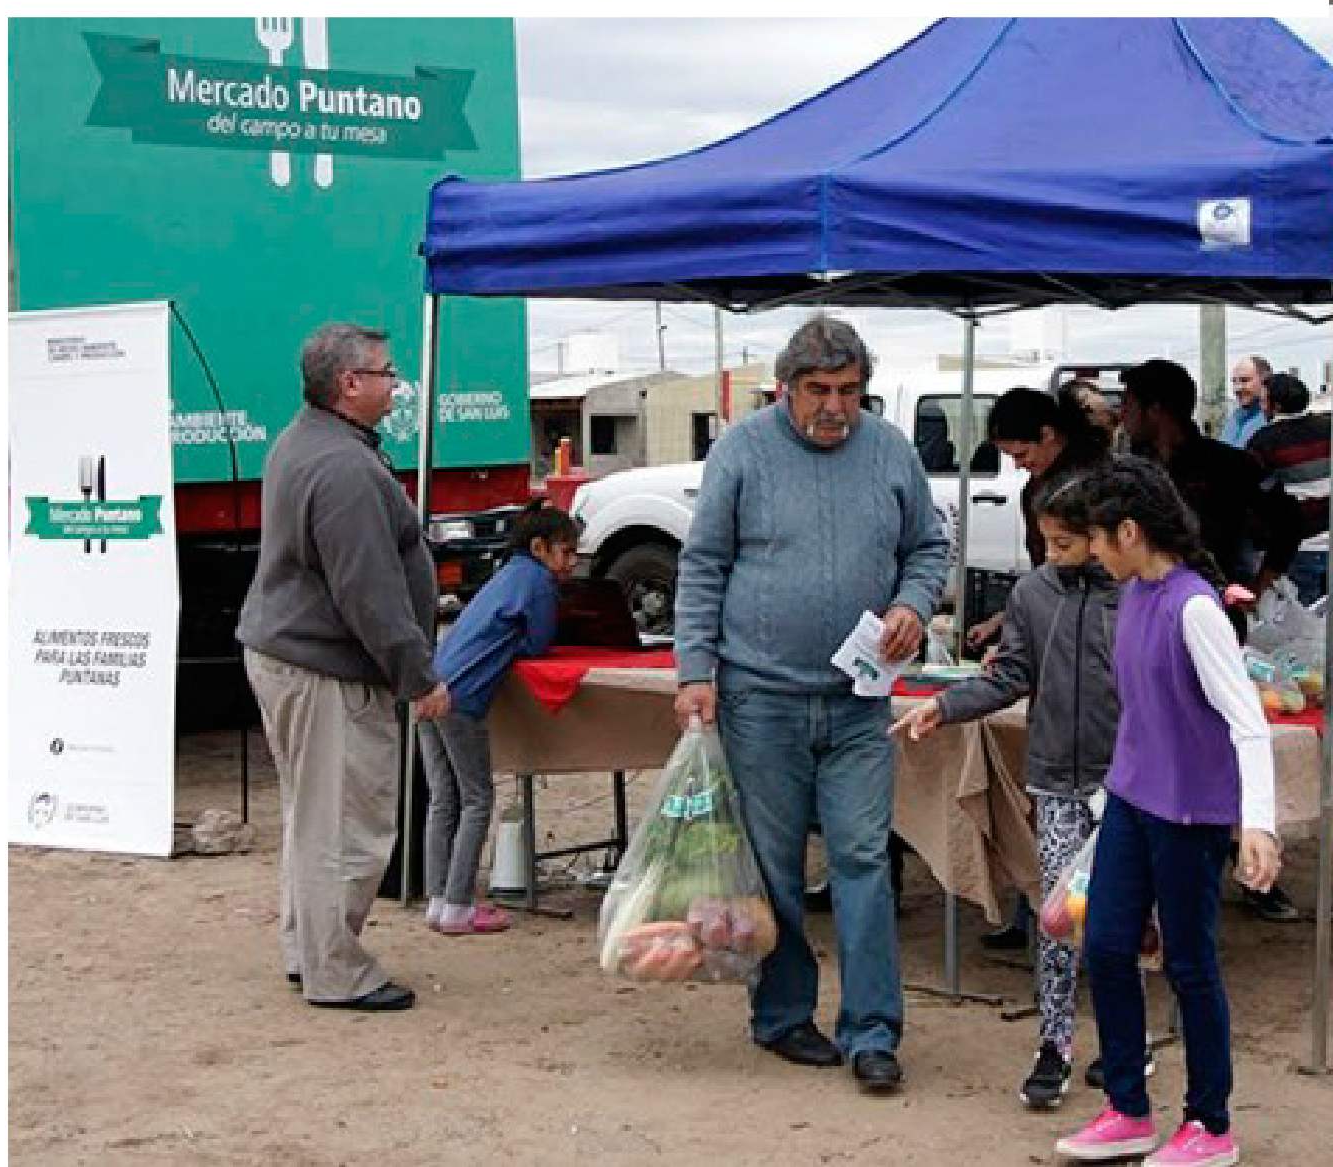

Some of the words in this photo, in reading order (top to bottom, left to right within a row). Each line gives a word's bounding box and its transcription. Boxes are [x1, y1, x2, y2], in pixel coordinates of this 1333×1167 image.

[167, 69, 290, 111] Mercado
[299, 80, 422, 121] Puntano
[206, 112, 236, 134] del
[241, 118, 301, 140] campo
[304, 123, 318, 140] a
[321, 121, 343, 140] tu
[346, 126, 388, 145] mesa
[34, 629, 98, 646] ALIMENTOS
[101, 631, 150, 649] FRESCOS
[34, 649, 65, 664] PARA
[70, 651, 91, 666] LAS
[93, 652, 147, 668] FAMILIAS
[59, 669, 120, 688] PUNTANAS
